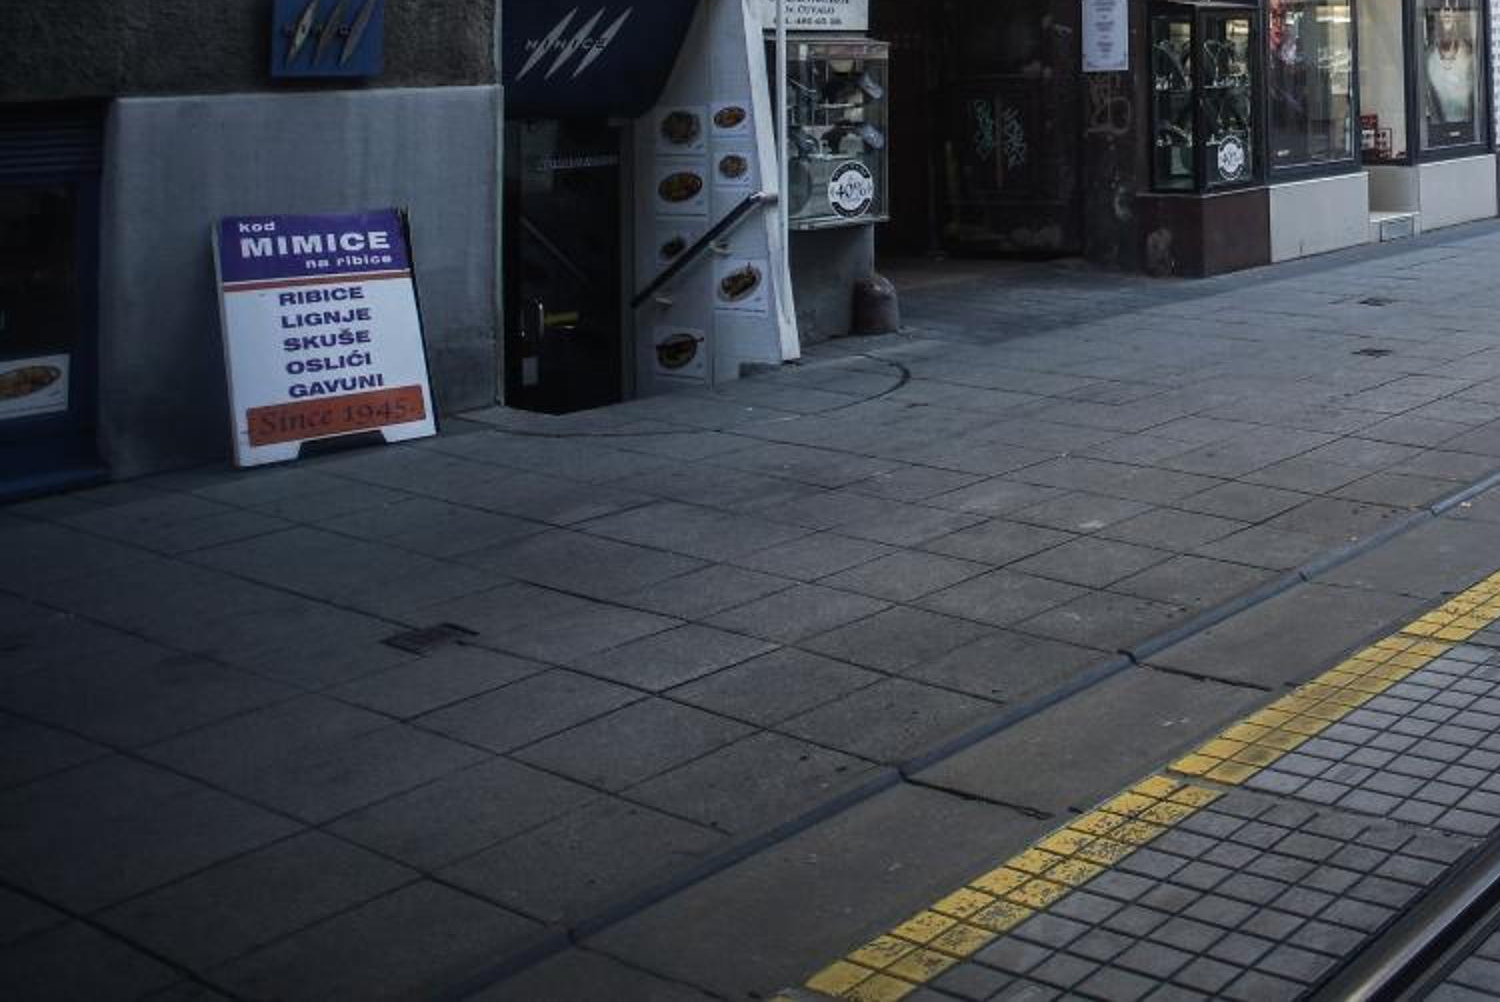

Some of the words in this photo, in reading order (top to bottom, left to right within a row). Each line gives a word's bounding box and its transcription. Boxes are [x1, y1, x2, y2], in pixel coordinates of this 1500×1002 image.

[239, 221, 275, 233] kod
[240, 230, 391, 259] MIMICE
[305, 259, 329, 269] na
[337, 253, 393, 268] ribice
[278, 285, 365, 307] RIBICE
[280, 307, 372, 329] LIGNJE
[283, 329, 372, 352] SKUŠE
[285, 349, 373, 375] OSLIĆI
[288, 373, 384, 399] GAVUNI
[257, 408, 333, 437] Since
